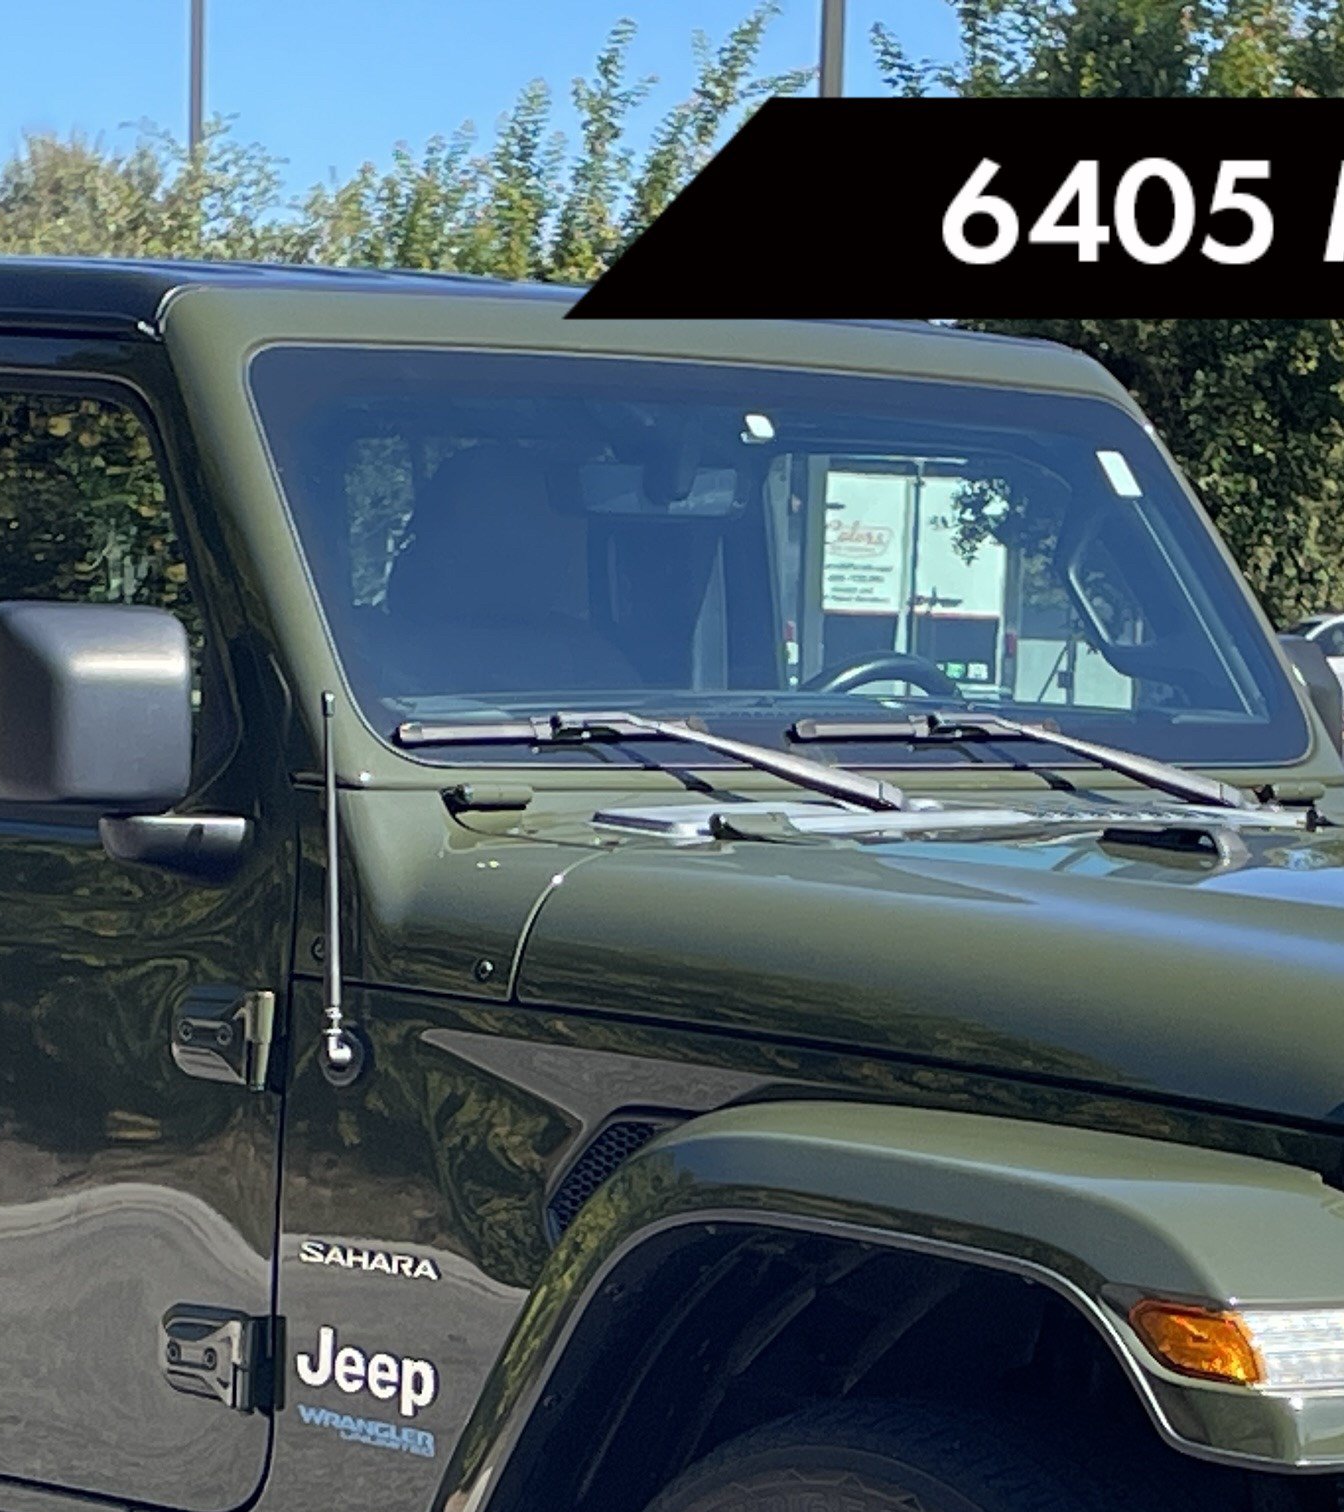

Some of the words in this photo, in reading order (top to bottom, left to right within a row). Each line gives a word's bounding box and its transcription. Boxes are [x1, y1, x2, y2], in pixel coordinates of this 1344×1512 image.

[299, 1240, 439, 1281] SAHARA
[296, 1326, 438, 1417] Jeep
[297, 1403, 435, 1451] WRANGLER
